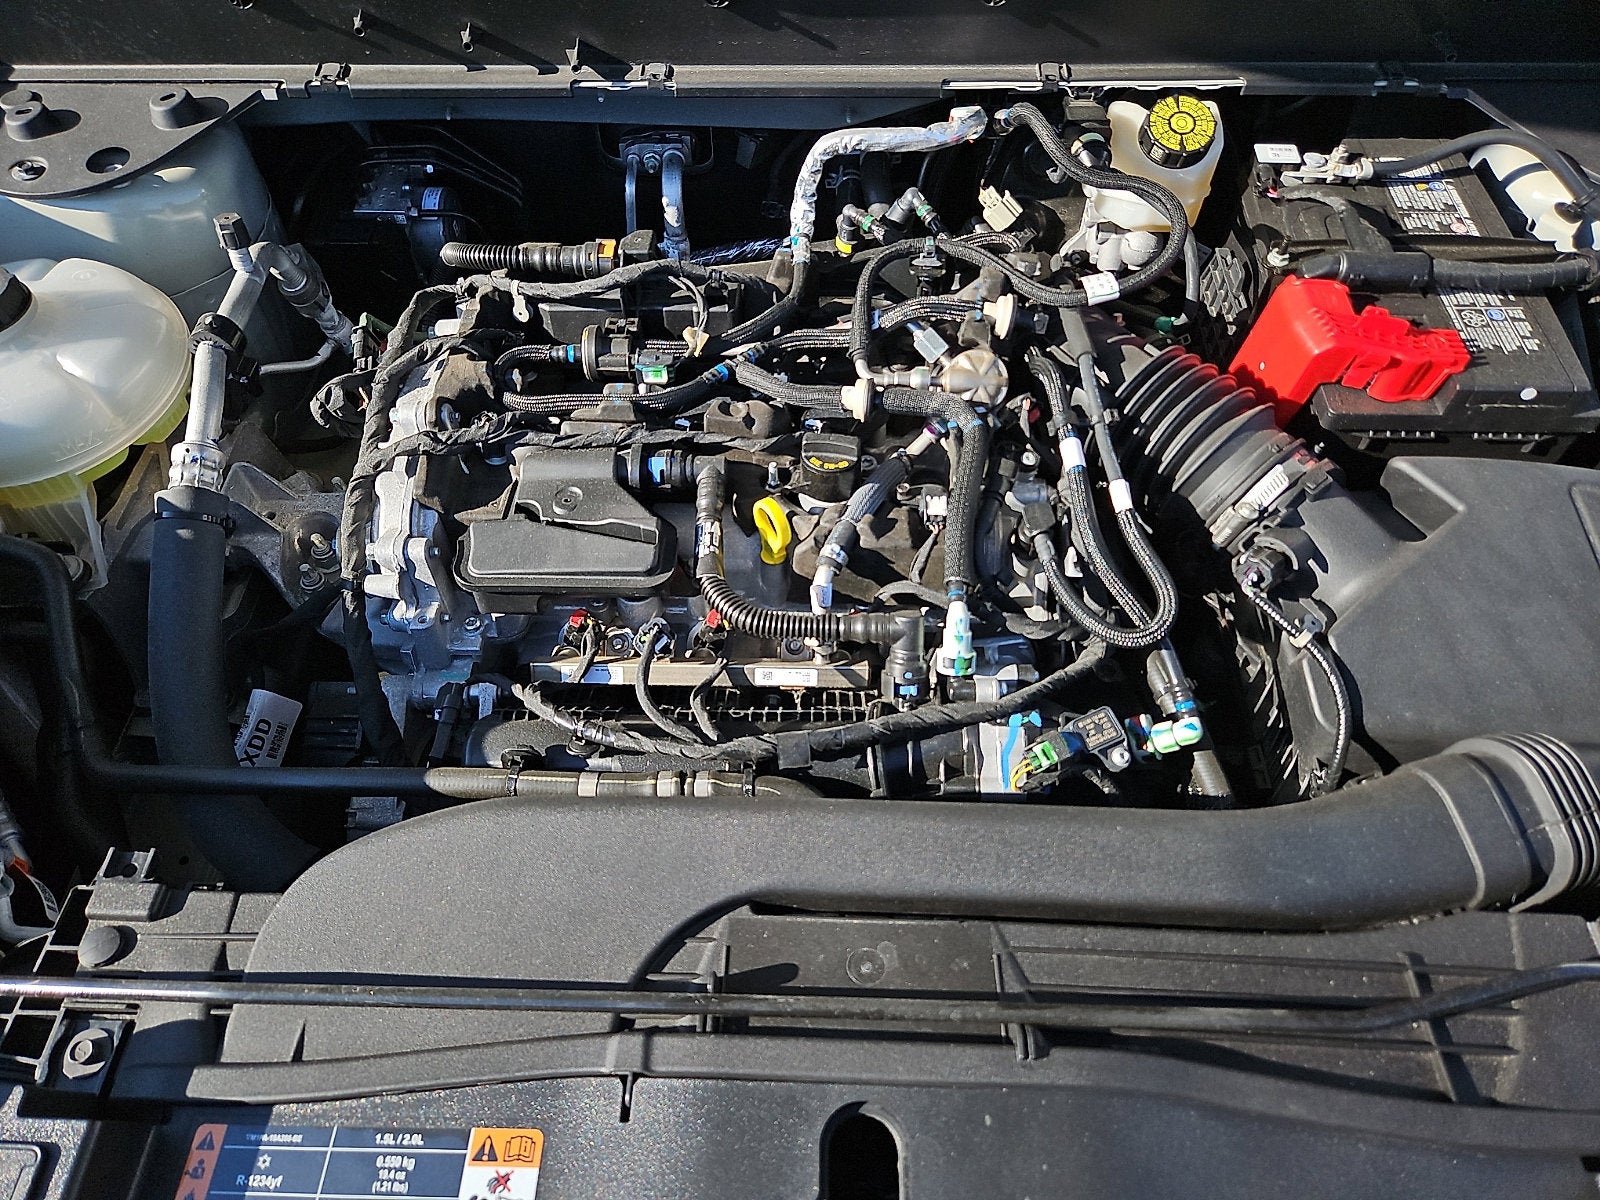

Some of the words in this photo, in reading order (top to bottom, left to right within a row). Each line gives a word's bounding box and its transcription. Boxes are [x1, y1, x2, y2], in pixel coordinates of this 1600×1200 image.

[239, 718, 272, 767] XDD
[375, 1132, 396, 1145] 1.5L
[402, 1133, 424, 1146] 2.0L
[402, 1155, 416, 1171] kg
[235, 1174, 283, 1191] R-1234yf
[395, 1171, 406, 1180] oz
